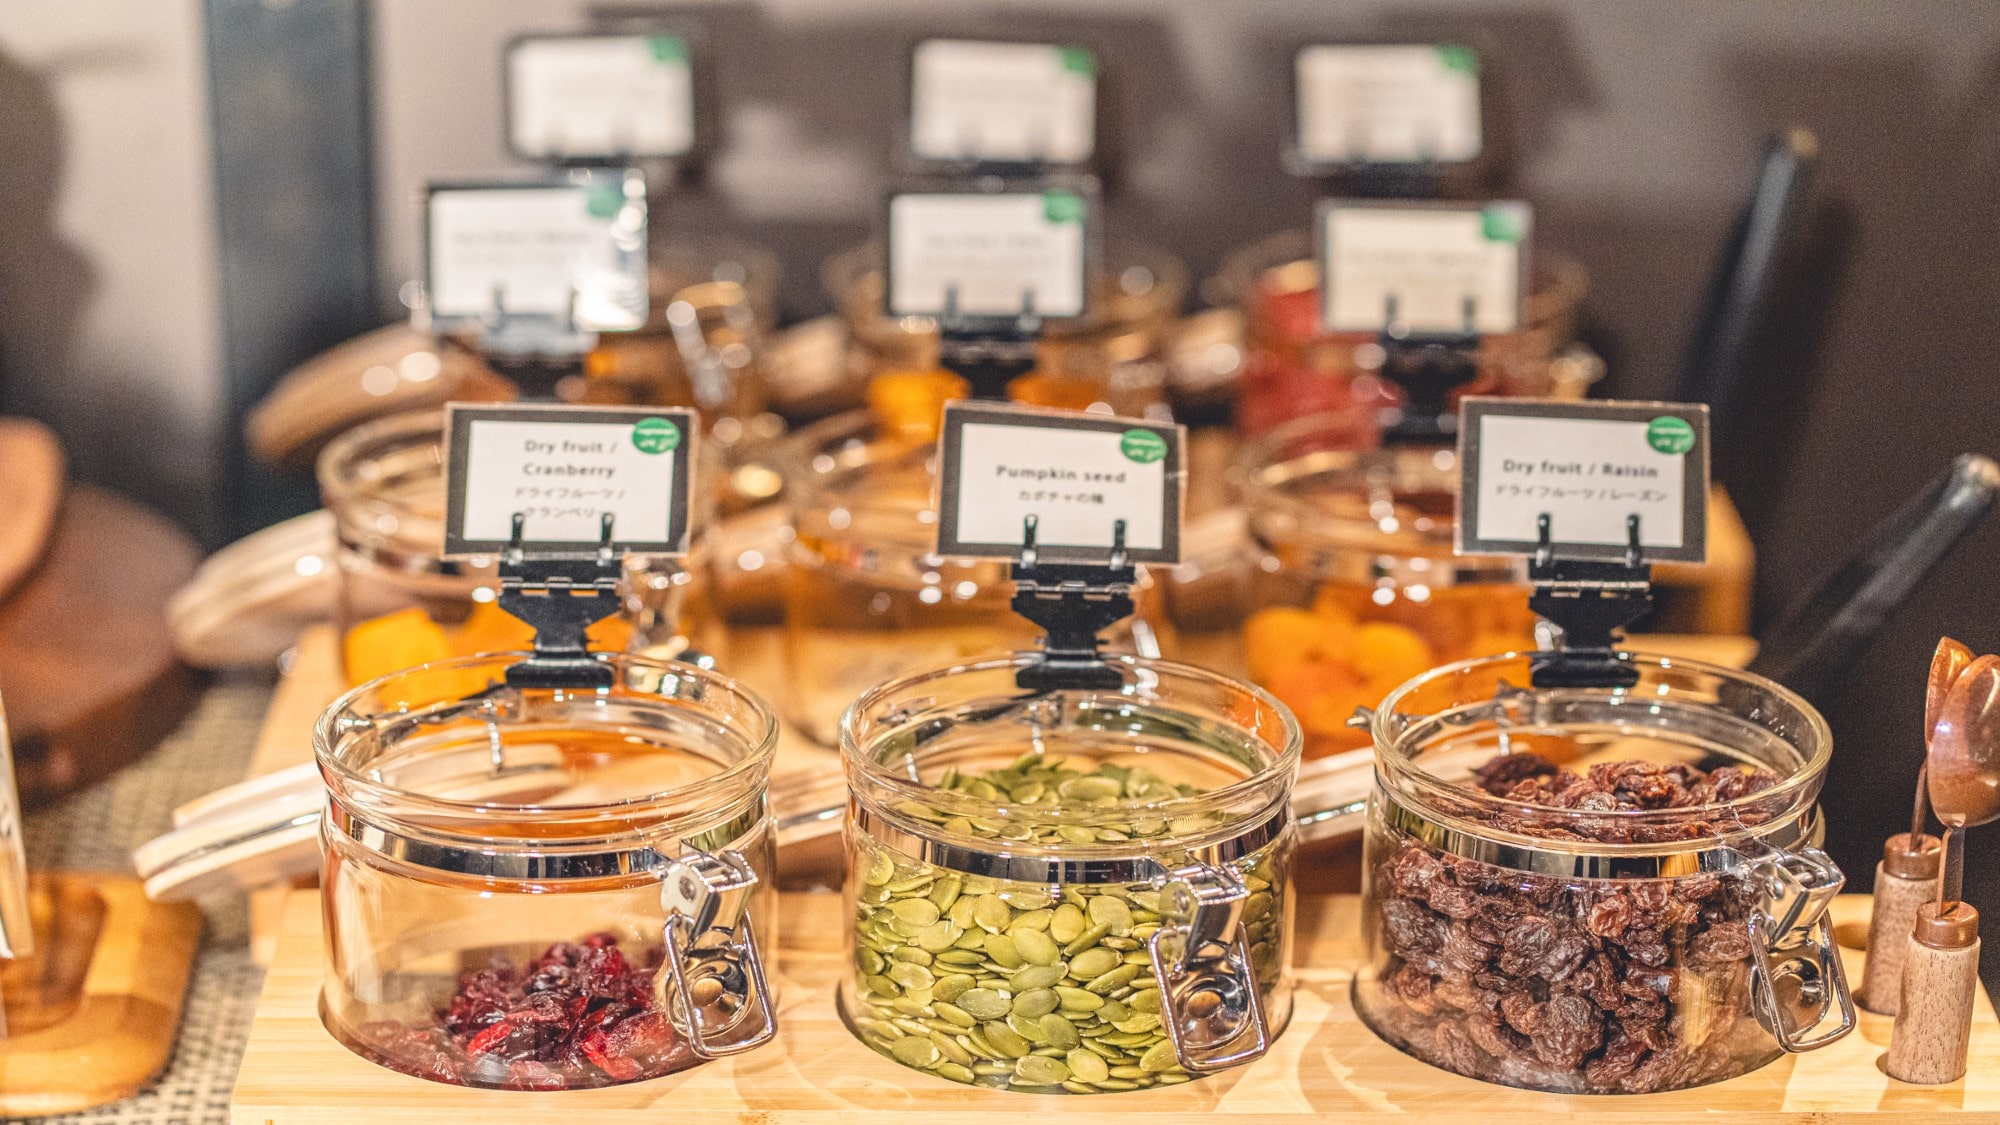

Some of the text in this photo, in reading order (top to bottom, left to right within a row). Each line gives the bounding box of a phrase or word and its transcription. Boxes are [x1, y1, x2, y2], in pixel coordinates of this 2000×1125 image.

[525, 439, 554, 455] Dry
[562, 439, 603, 453] fruit
[523, 462, 616, 480] Cranberry
[997, 465, 1127, 484] Pumpkin seed
[1503, 459, 1534, 476] Dry
[1541, 460, 1582, 475] fruit
[1602, 462, 1659, 478] Raisin
